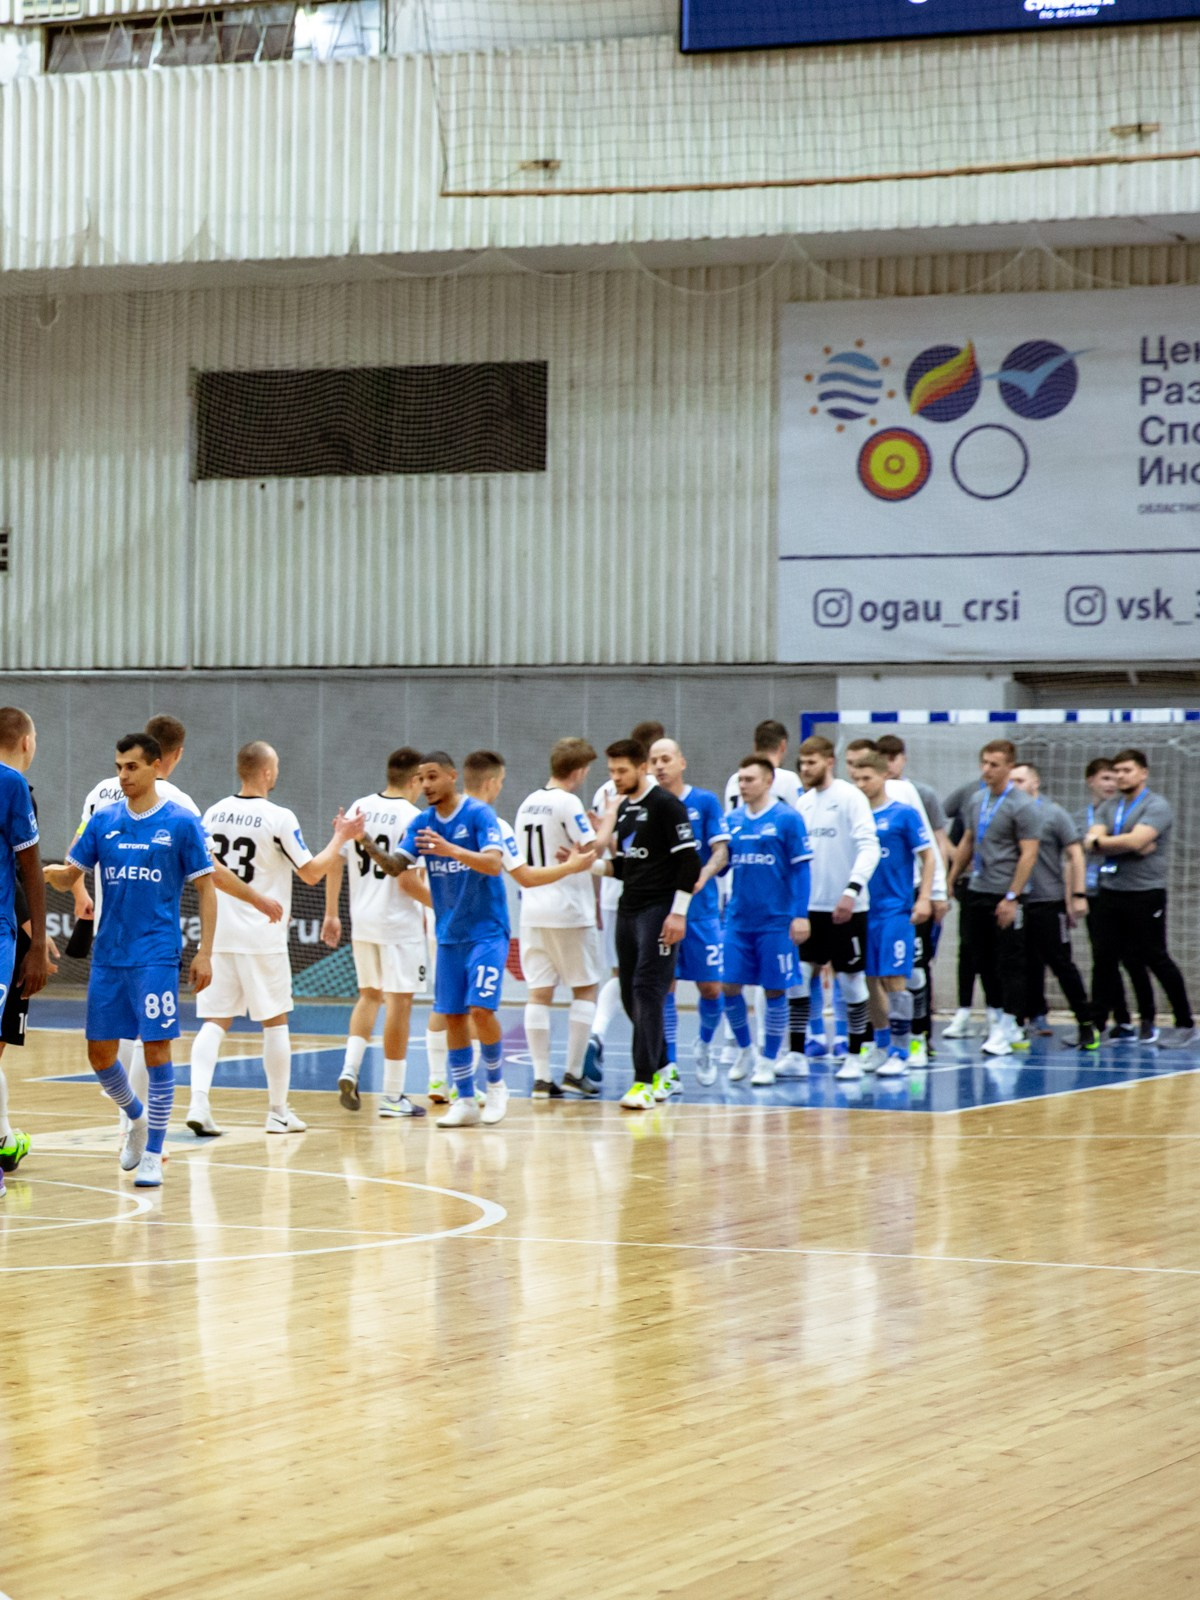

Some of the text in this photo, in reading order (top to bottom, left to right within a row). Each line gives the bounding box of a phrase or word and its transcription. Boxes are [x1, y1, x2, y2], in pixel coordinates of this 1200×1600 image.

[1140, 376, 1200, 406] Раз
[859, 590, 1020, 630] ogau_crsi
[211, 812, 262, 828] ИВАНОВ
[524, 823, 546, 867] 11
[105, 866, 162, 882] IRAERO
[893, 940, 907, 960] 8
[476, 965, 500, 991] 12
[145, 991, 176, 1019] 88
